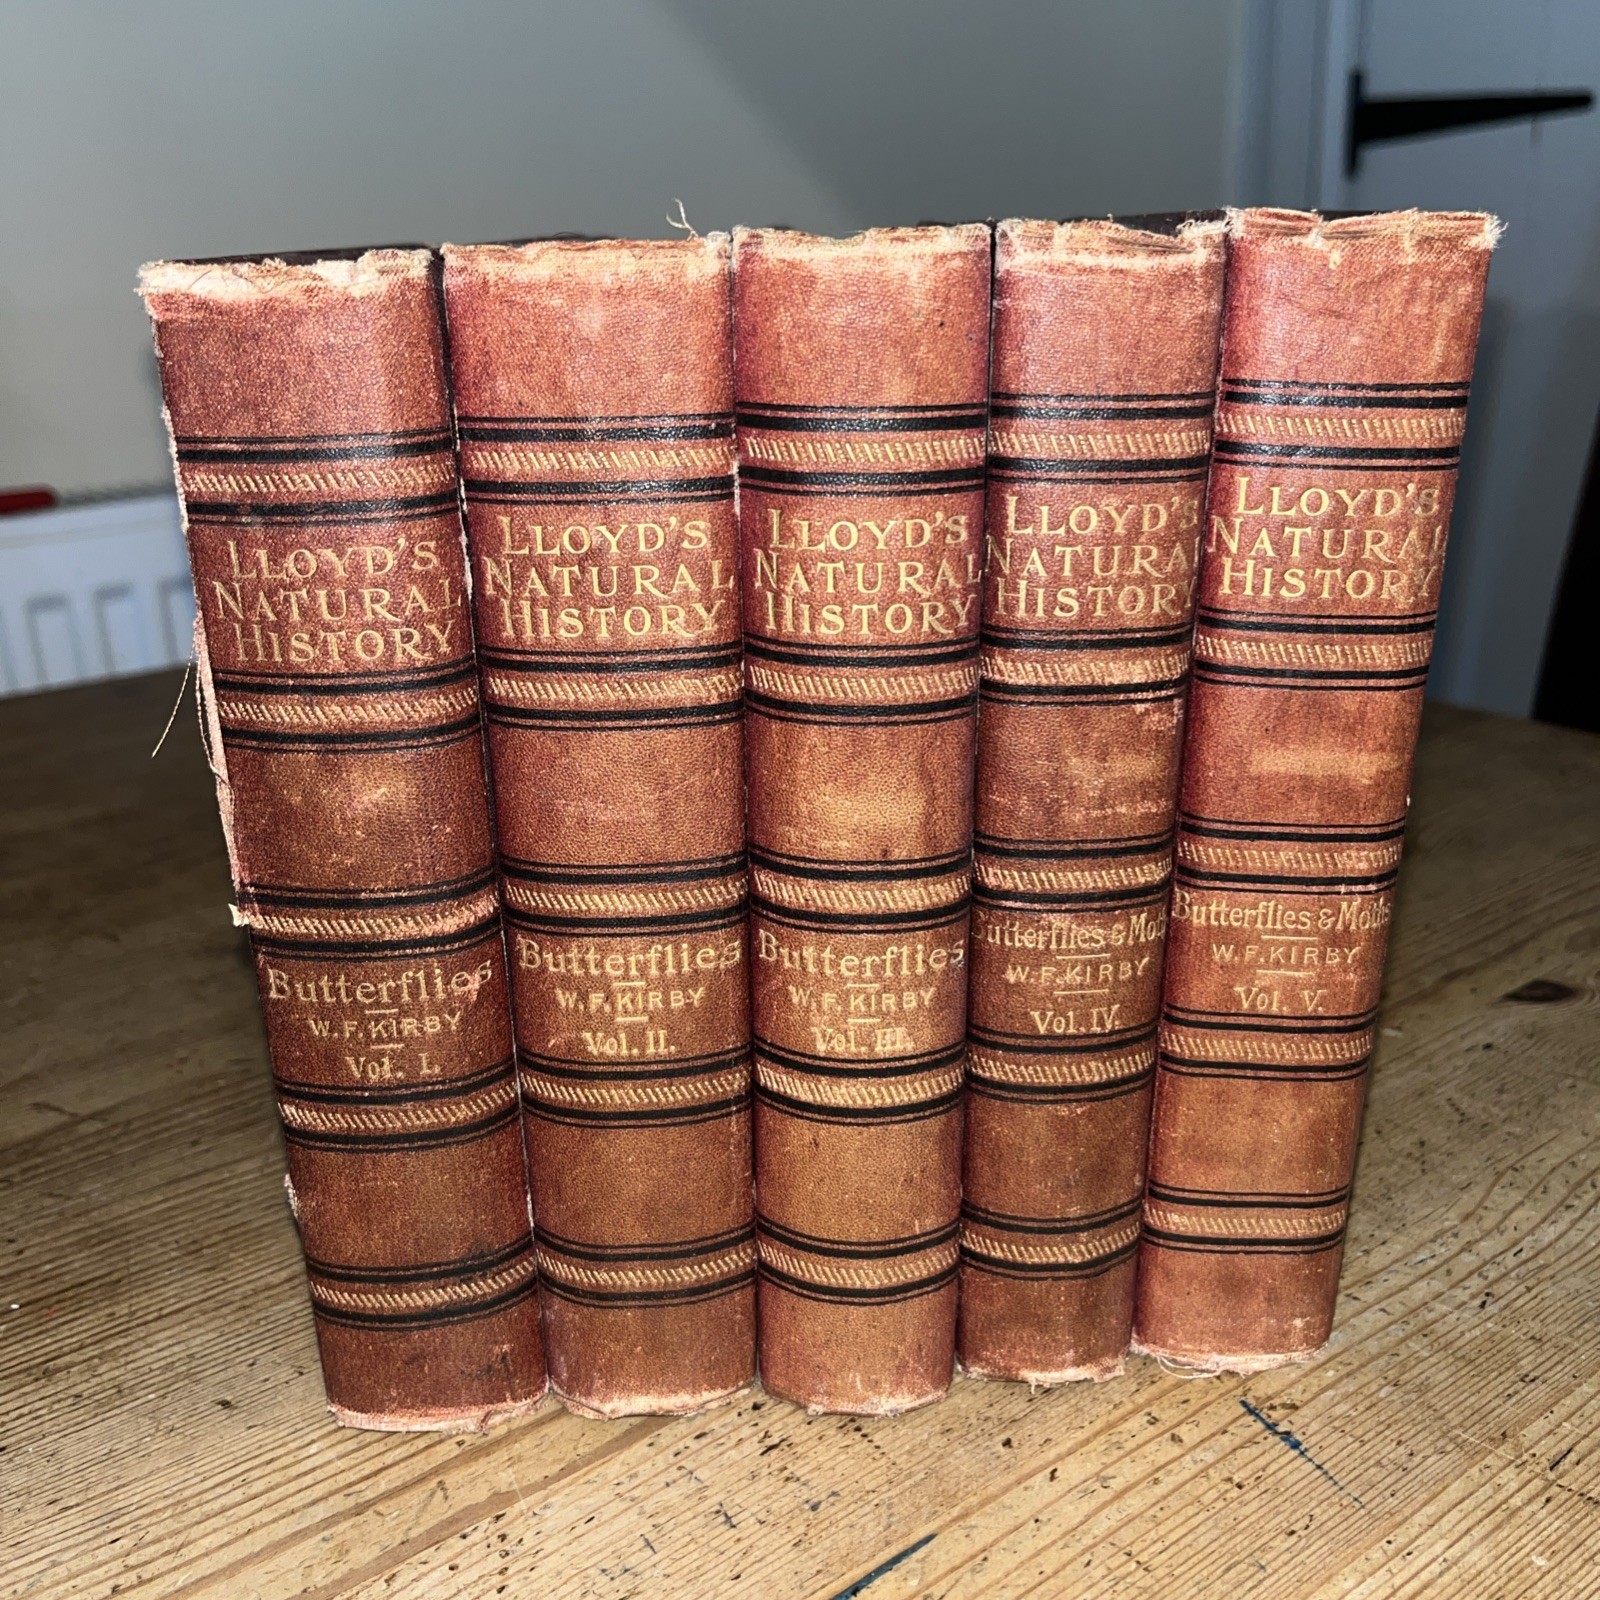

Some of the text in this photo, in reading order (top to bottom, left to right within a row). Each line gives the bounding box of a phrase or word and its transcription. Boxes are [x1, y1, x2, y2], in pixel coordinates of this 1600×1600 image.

[1004, 495, 1198, 535] LLOYD'S
[1233, 476, 1439, 517] LLOYD'S
[498, 515, 712, 555] LLOYD'S
[768, 508, 969, 552] LLOYD'S
[227, 537, 438, 579] LLOYD'S
[482, 556, 735, 599] NATURAL
[753, 548, 982, 598] NATURAL
[212, 579, 462, 622] NATURAL
[501, 598, 726, 638] HISTORY
[766, 591, 977, 635] HISTORY
[995, 576, 1197, 618] HISTORY
[233, 619, 456, 663] HISTORY
[1172, 890, 1312, 930] Butterflies
[1318, 908, 1335, 930] &
[516, 934, 742, 976] Butterflies
[758, 928, 964, 977] Butterflies
[268, 960, 492, 1004] Butterflies
[1234, 986, 1327, 1013] Vol. V.
[583, 1029, 675, 1055] Vol. II.
[810, 1026, 868, 1051] Vol.
[1030, 1010, 1086, 1035] Vol.
[345, 1054, 403, 1080] Vol.
